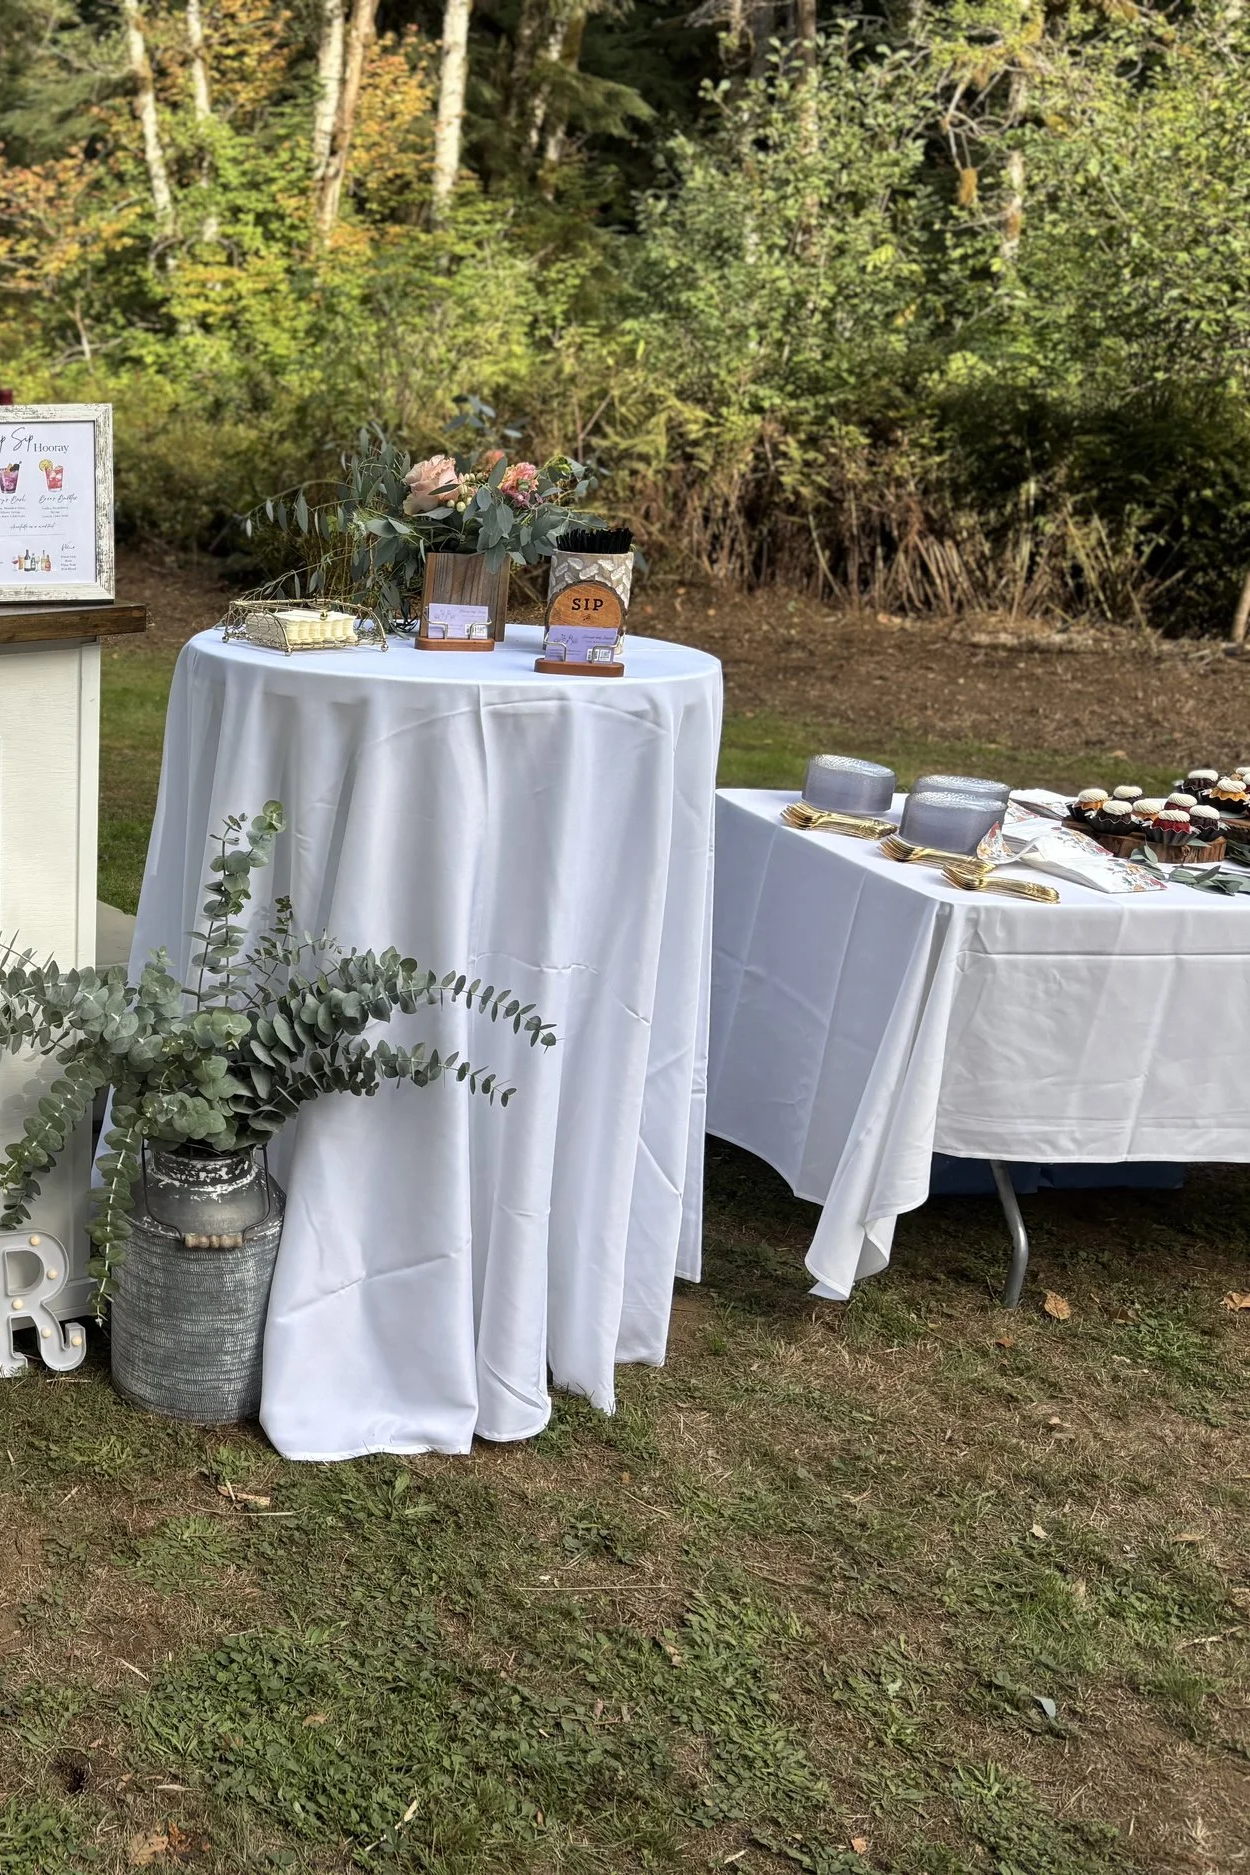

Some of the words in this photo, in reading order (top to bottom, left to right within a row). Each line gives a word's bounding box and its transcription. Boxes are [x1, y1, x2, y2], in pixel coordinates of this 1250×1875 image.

[10, 426, 34, 452] Sip
[34, 442, 69, 454] Hooray
[571, 598, 604, 611] SIP
